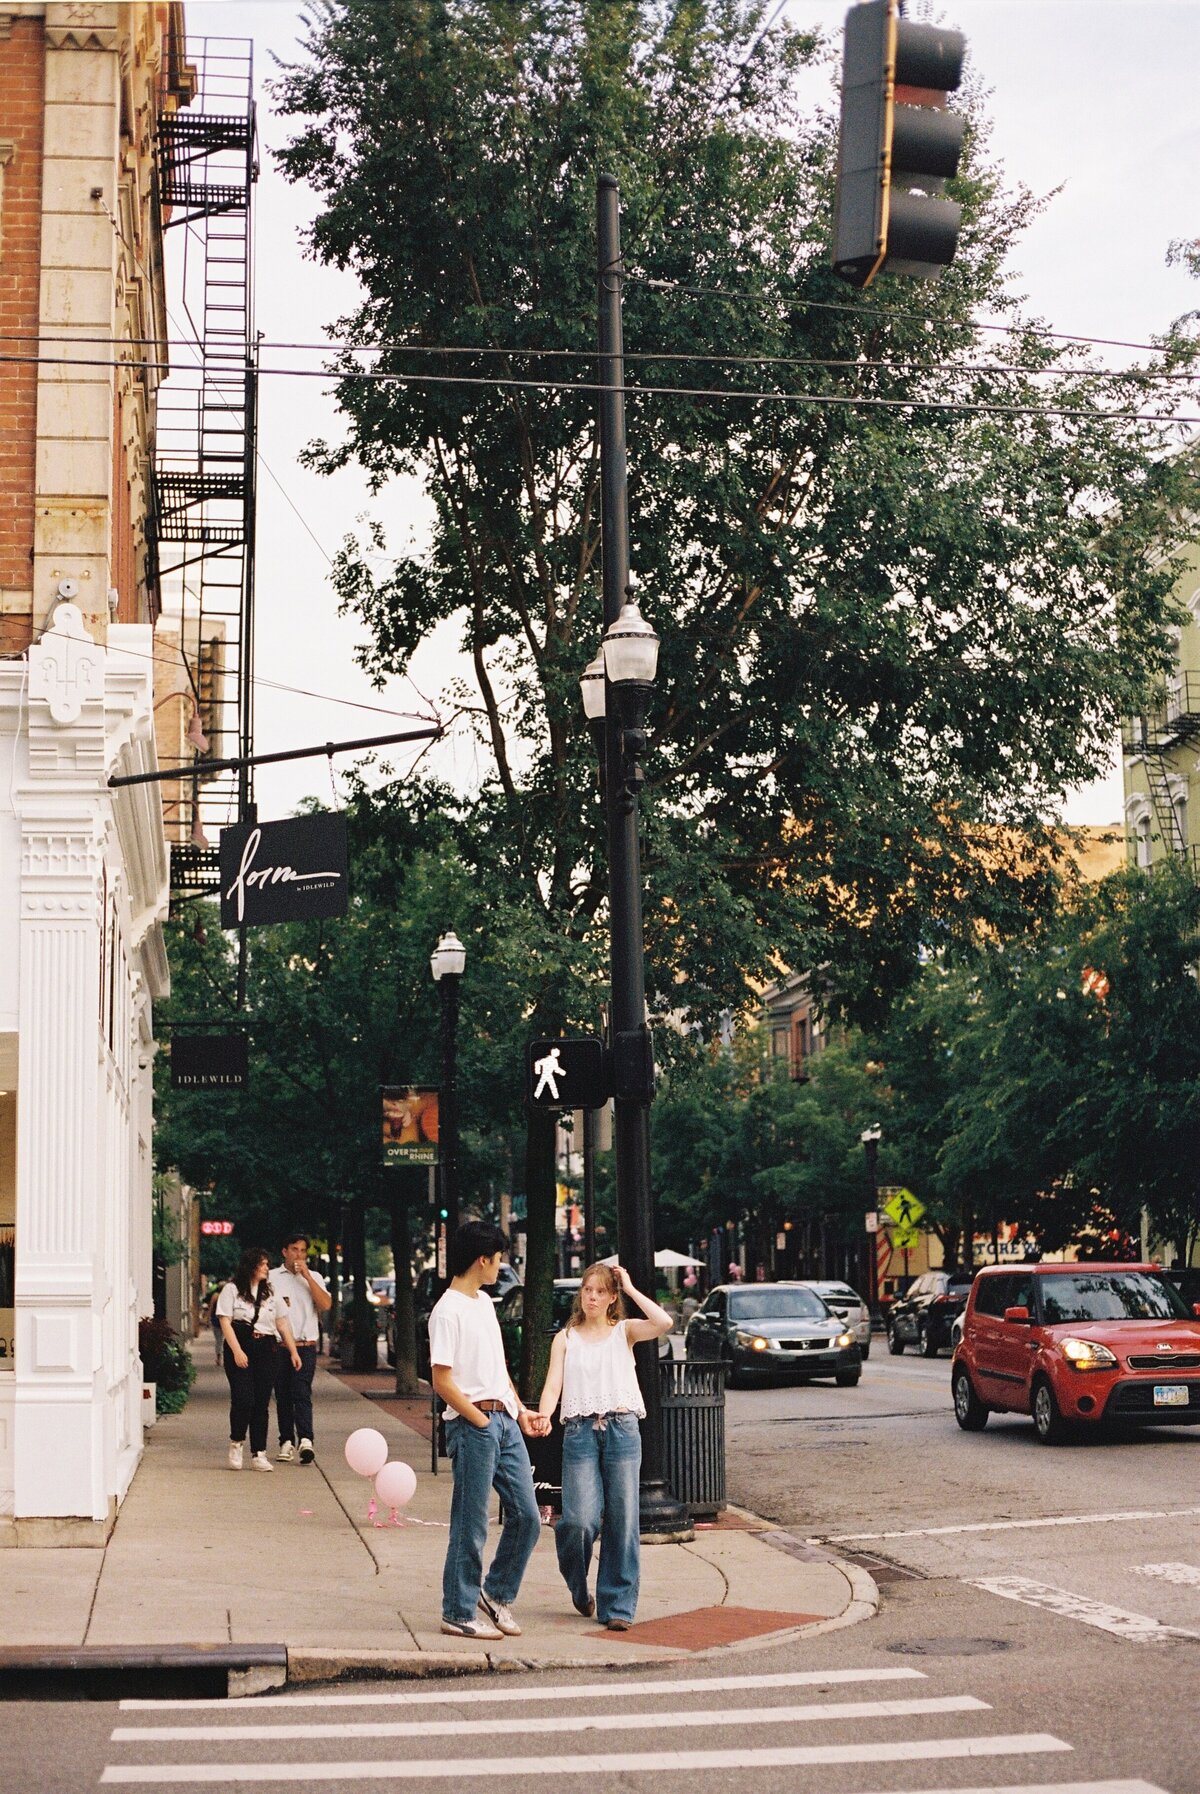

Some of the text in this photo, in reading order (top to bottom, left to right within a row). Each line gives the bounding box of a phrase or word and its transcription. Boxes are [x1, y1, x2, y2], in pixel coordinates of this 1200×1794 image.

[226, 828, 341, 922] form
[303, 882, 335, 891] IDLEWILD
[177, 1075, 242, 1084] IDLEWILD
[387, 1148, 409, 1156] OVER
